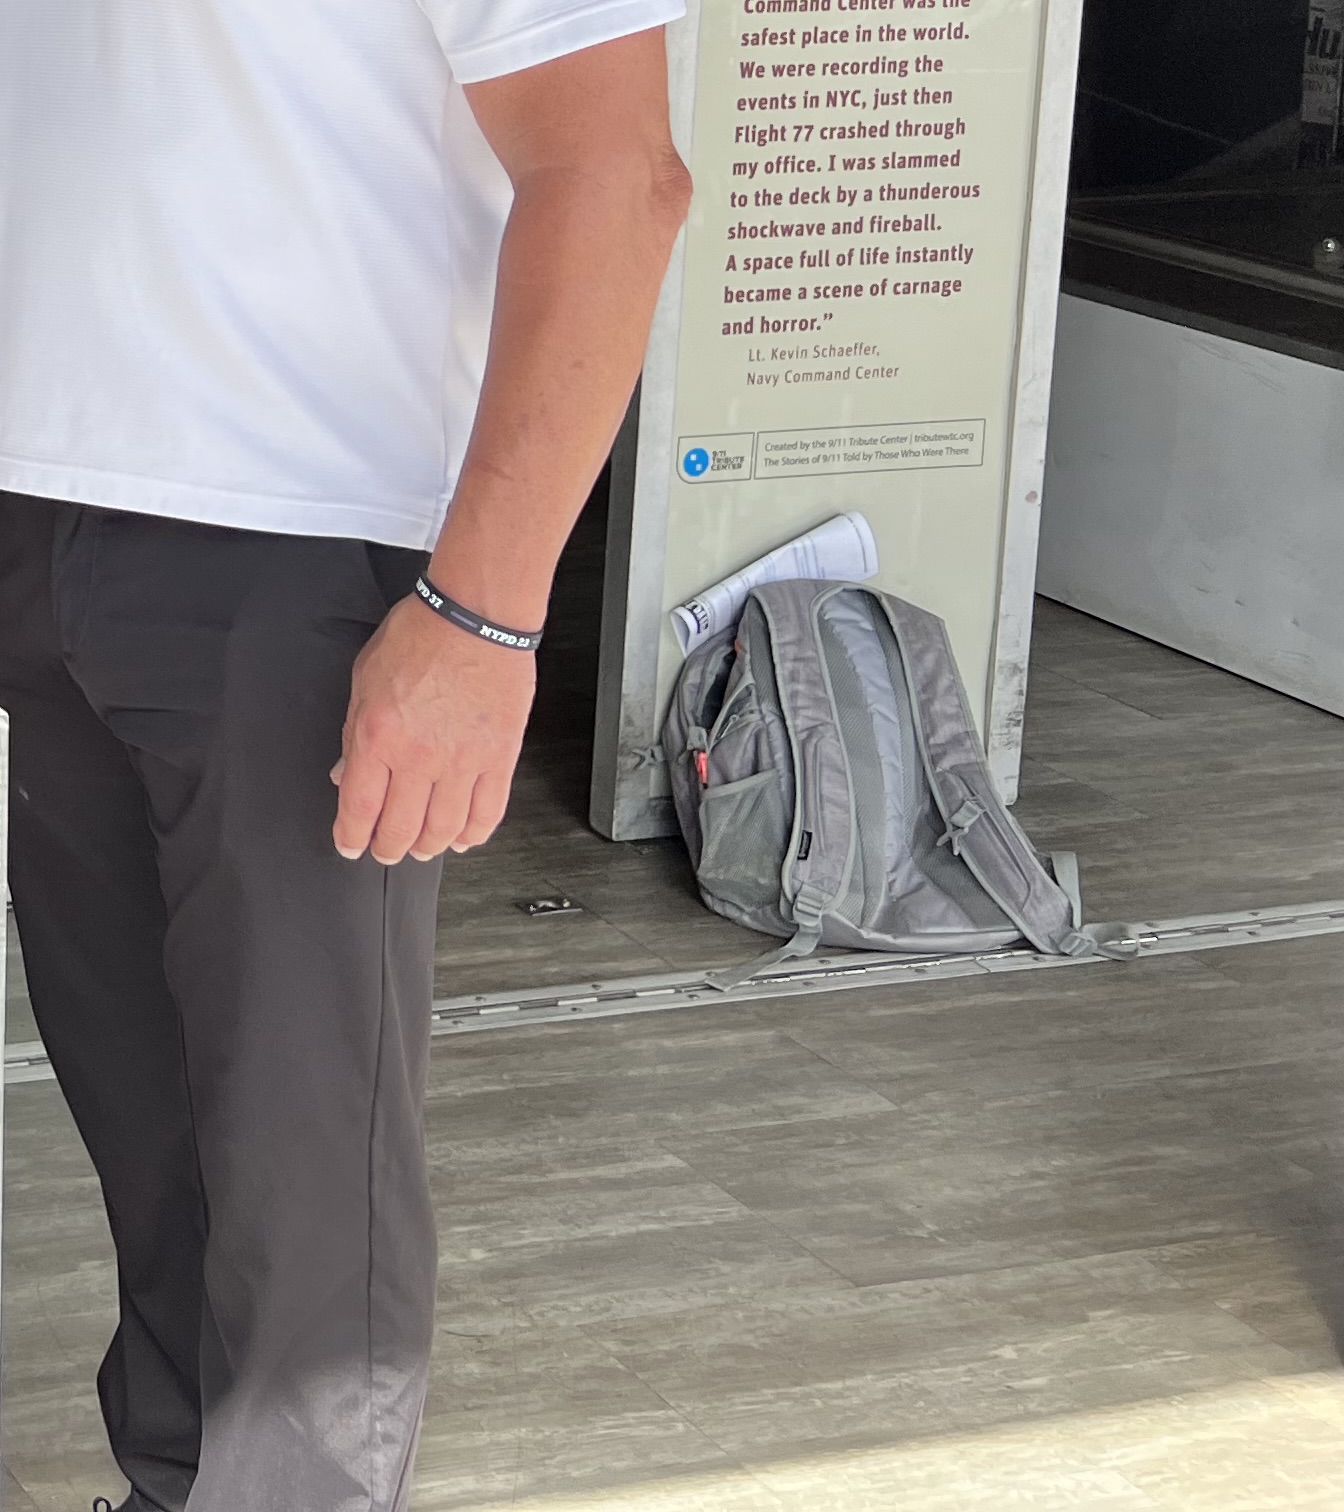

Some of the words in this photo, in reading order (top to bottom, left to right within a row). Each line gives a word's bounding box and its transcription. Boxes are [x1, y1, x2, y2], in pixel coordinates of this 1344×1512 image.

[734, 123, 787, 147] Flight
[793, 124, 814, 143] 77
[820, 120, 890, 140] crashed
[895, 117, 965, 140] through
[727, 220, 826, 240] shockwave
[831, 216, 864, 235] and
[870, 213, 942, 233] fireball.
[722, 316, 754, 336] and
[760, 312, 833, 334] horror."
[748, 348, 765, 362] Lt.
[771, 345, 808, 361] Kevin
[813, 342, 880, 359] Schaeffer,
[746, 372, 780, 386] Navy
[784, 366, 851, 384] Command
[855, 366, 899, 380] Center
[479, 624, 518, 645] NYPD
